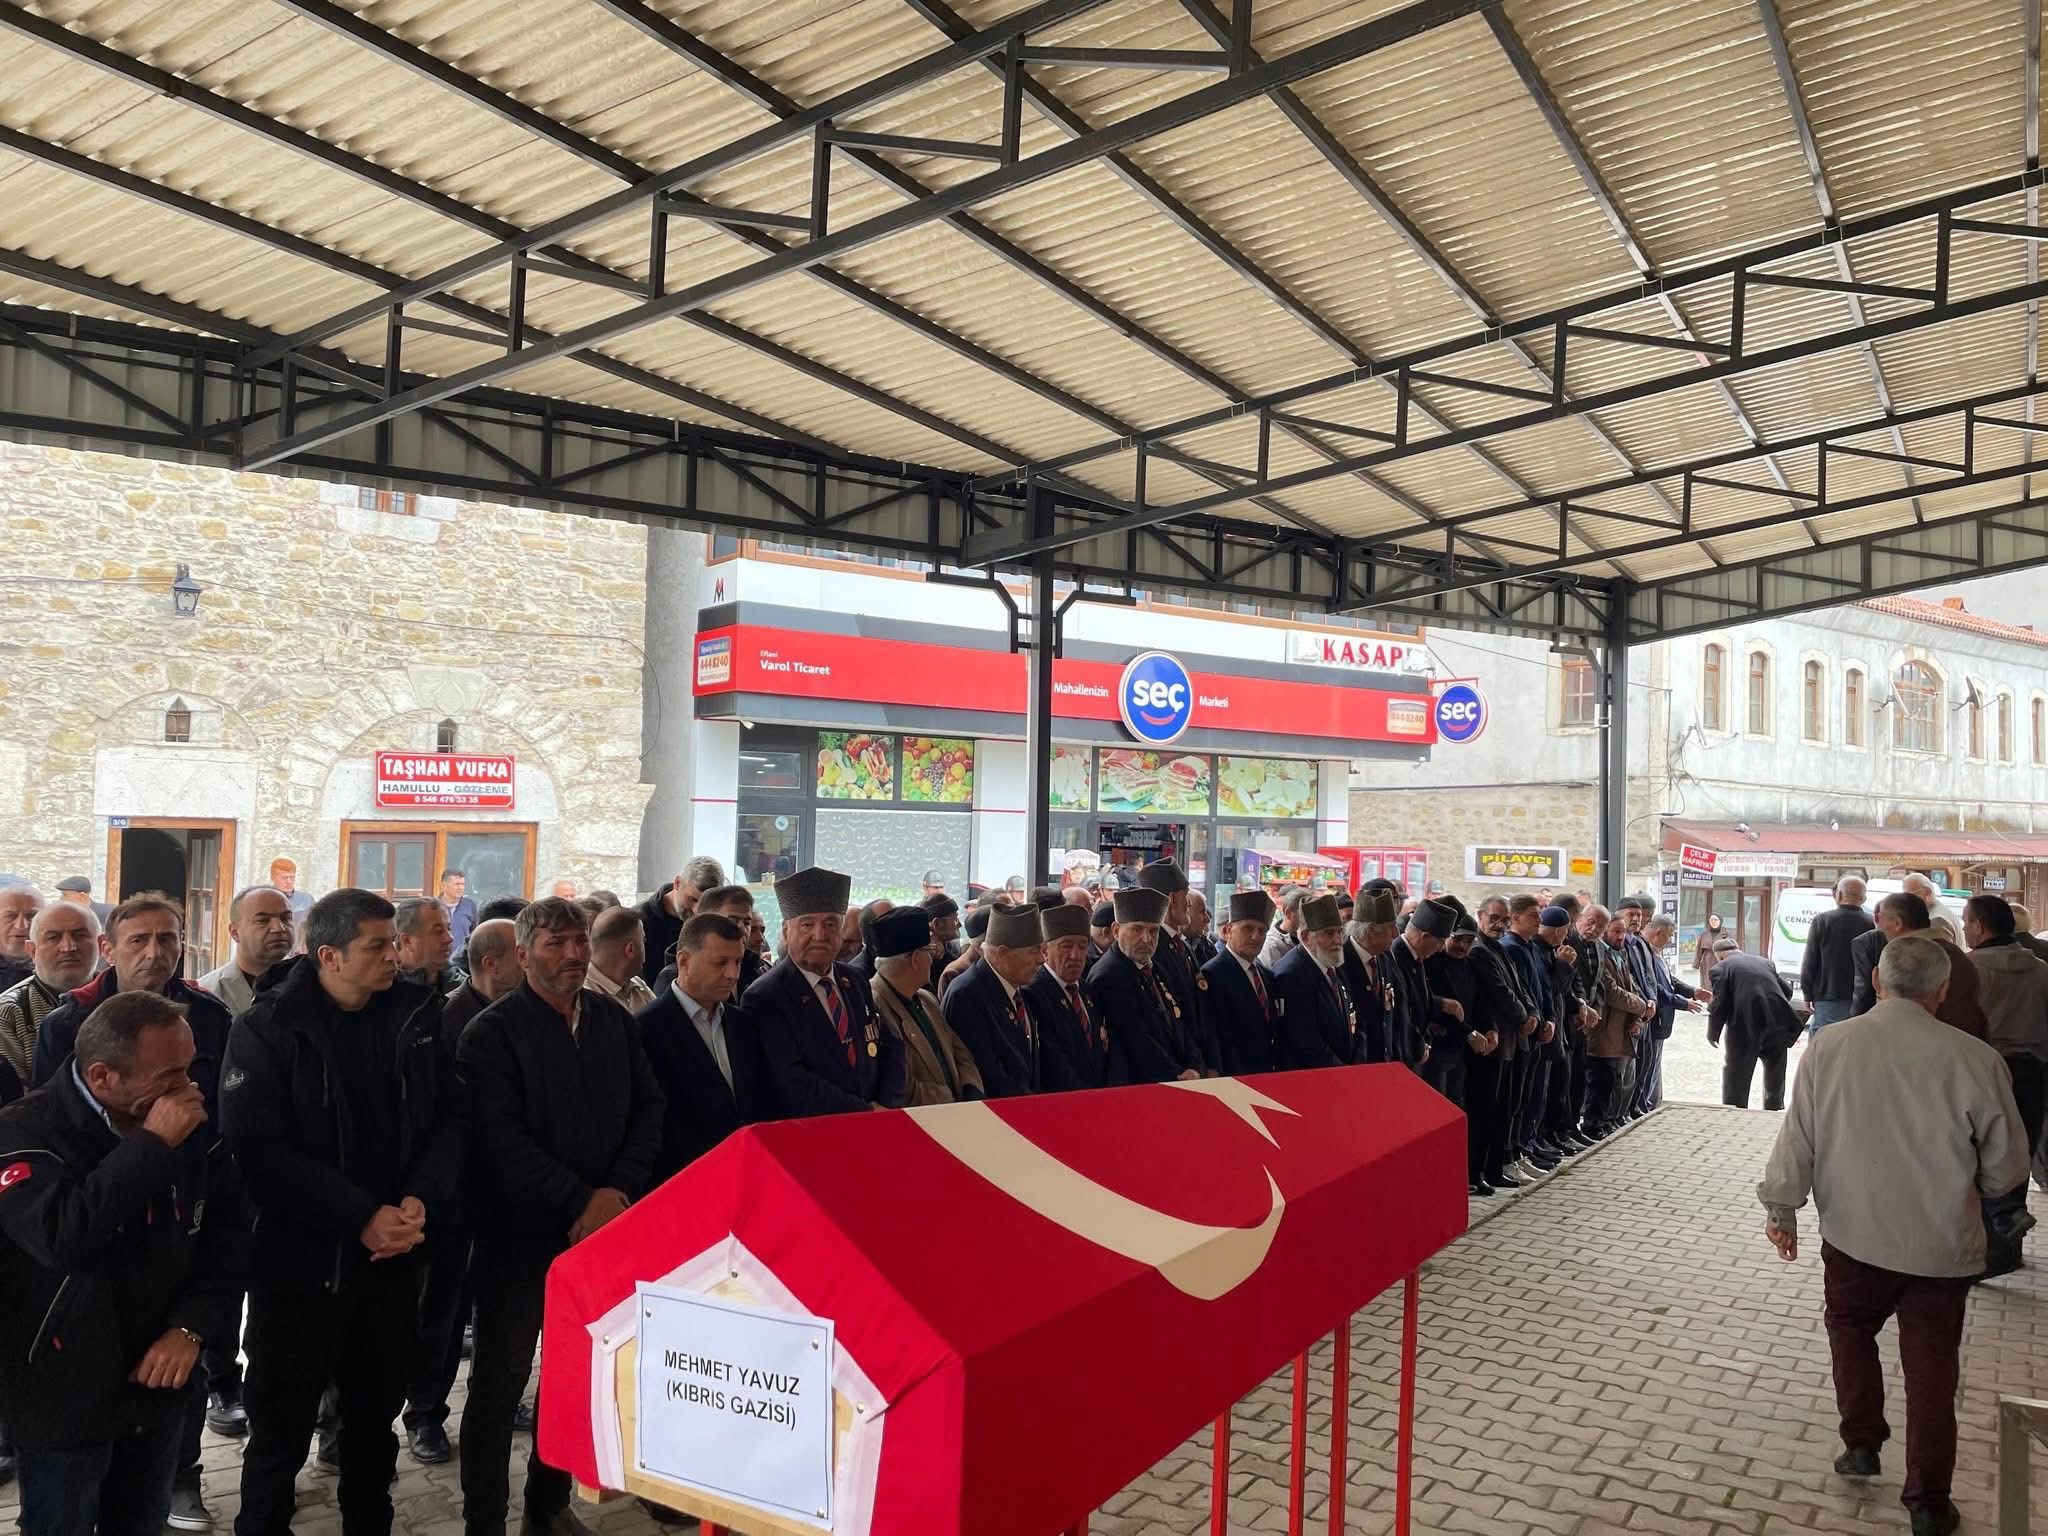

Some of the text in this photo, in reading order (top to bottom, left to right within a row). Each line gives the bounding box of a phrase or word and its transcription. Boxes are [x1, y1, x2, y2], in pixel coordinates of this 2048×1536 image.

[1323, 638, 1403, 667] KASAP
[760, 660, 831, 675] Varol Ticaret
[1053, 682, 1109, 698] Mahallenizin
[1132, 679, 1185, 713] seç
[1199, 695, 1229, 708] Marketi
[1440, 701, 1478, 722] seç
[383, 758, 508, 780] TAŞHAN YUFKA
[382, 783, 441, 793] HAMULLU
[454, 785, 509, 794] GÖZLEME
[1482, 853, 1552, 866] PİLAVCI
[1689, 848, 1710, 860] ÇELİK
[1682, 855, 1714, 871] HAFRİYAT
[1785, 916, 1813, 924] CENAZ
[664, 1350, 800, 1396] MEHMET YAVUZ
[666, 1379, 796, 1431] (KIBRIS GAZİSİ)
